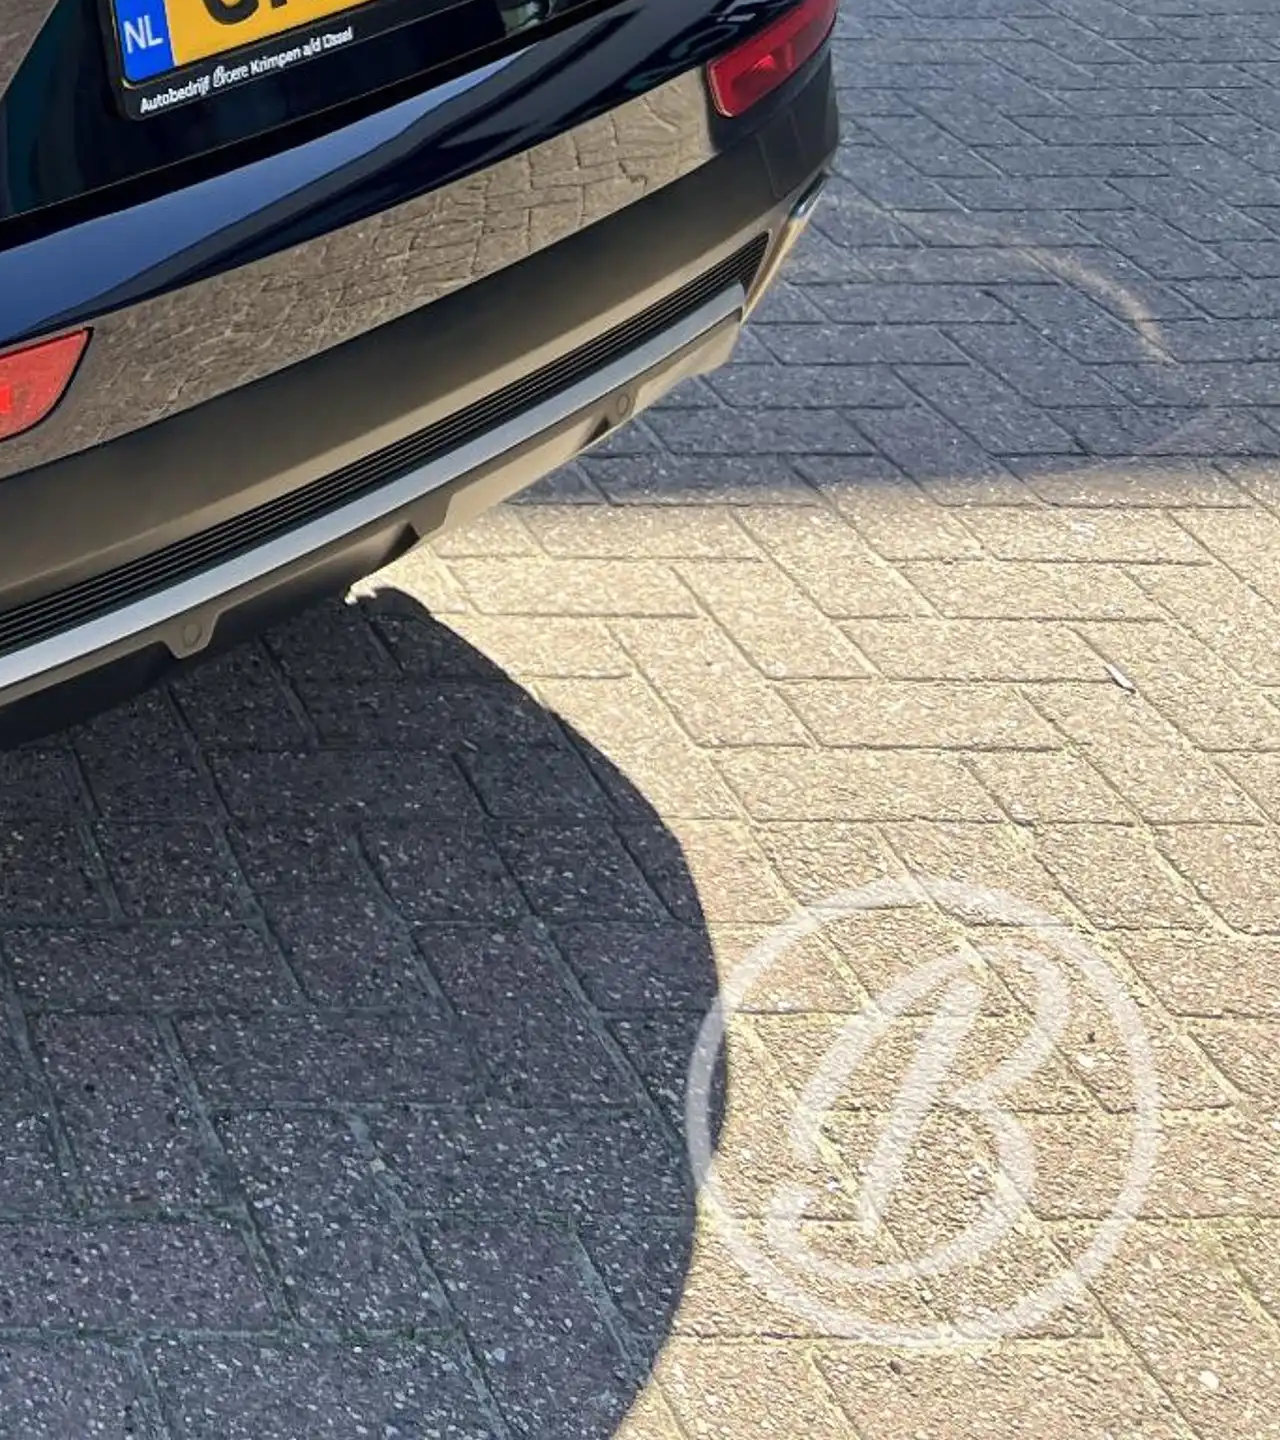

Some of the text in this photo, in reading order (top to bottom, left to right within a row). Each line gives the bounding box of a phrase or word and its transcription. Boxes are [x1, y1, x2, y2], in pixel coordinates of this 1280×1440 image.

[124, 14, 163, 54] NL
[140, 74, 211, 114] Autobedrijf
[250, 44, 302, 75] Krimpen
